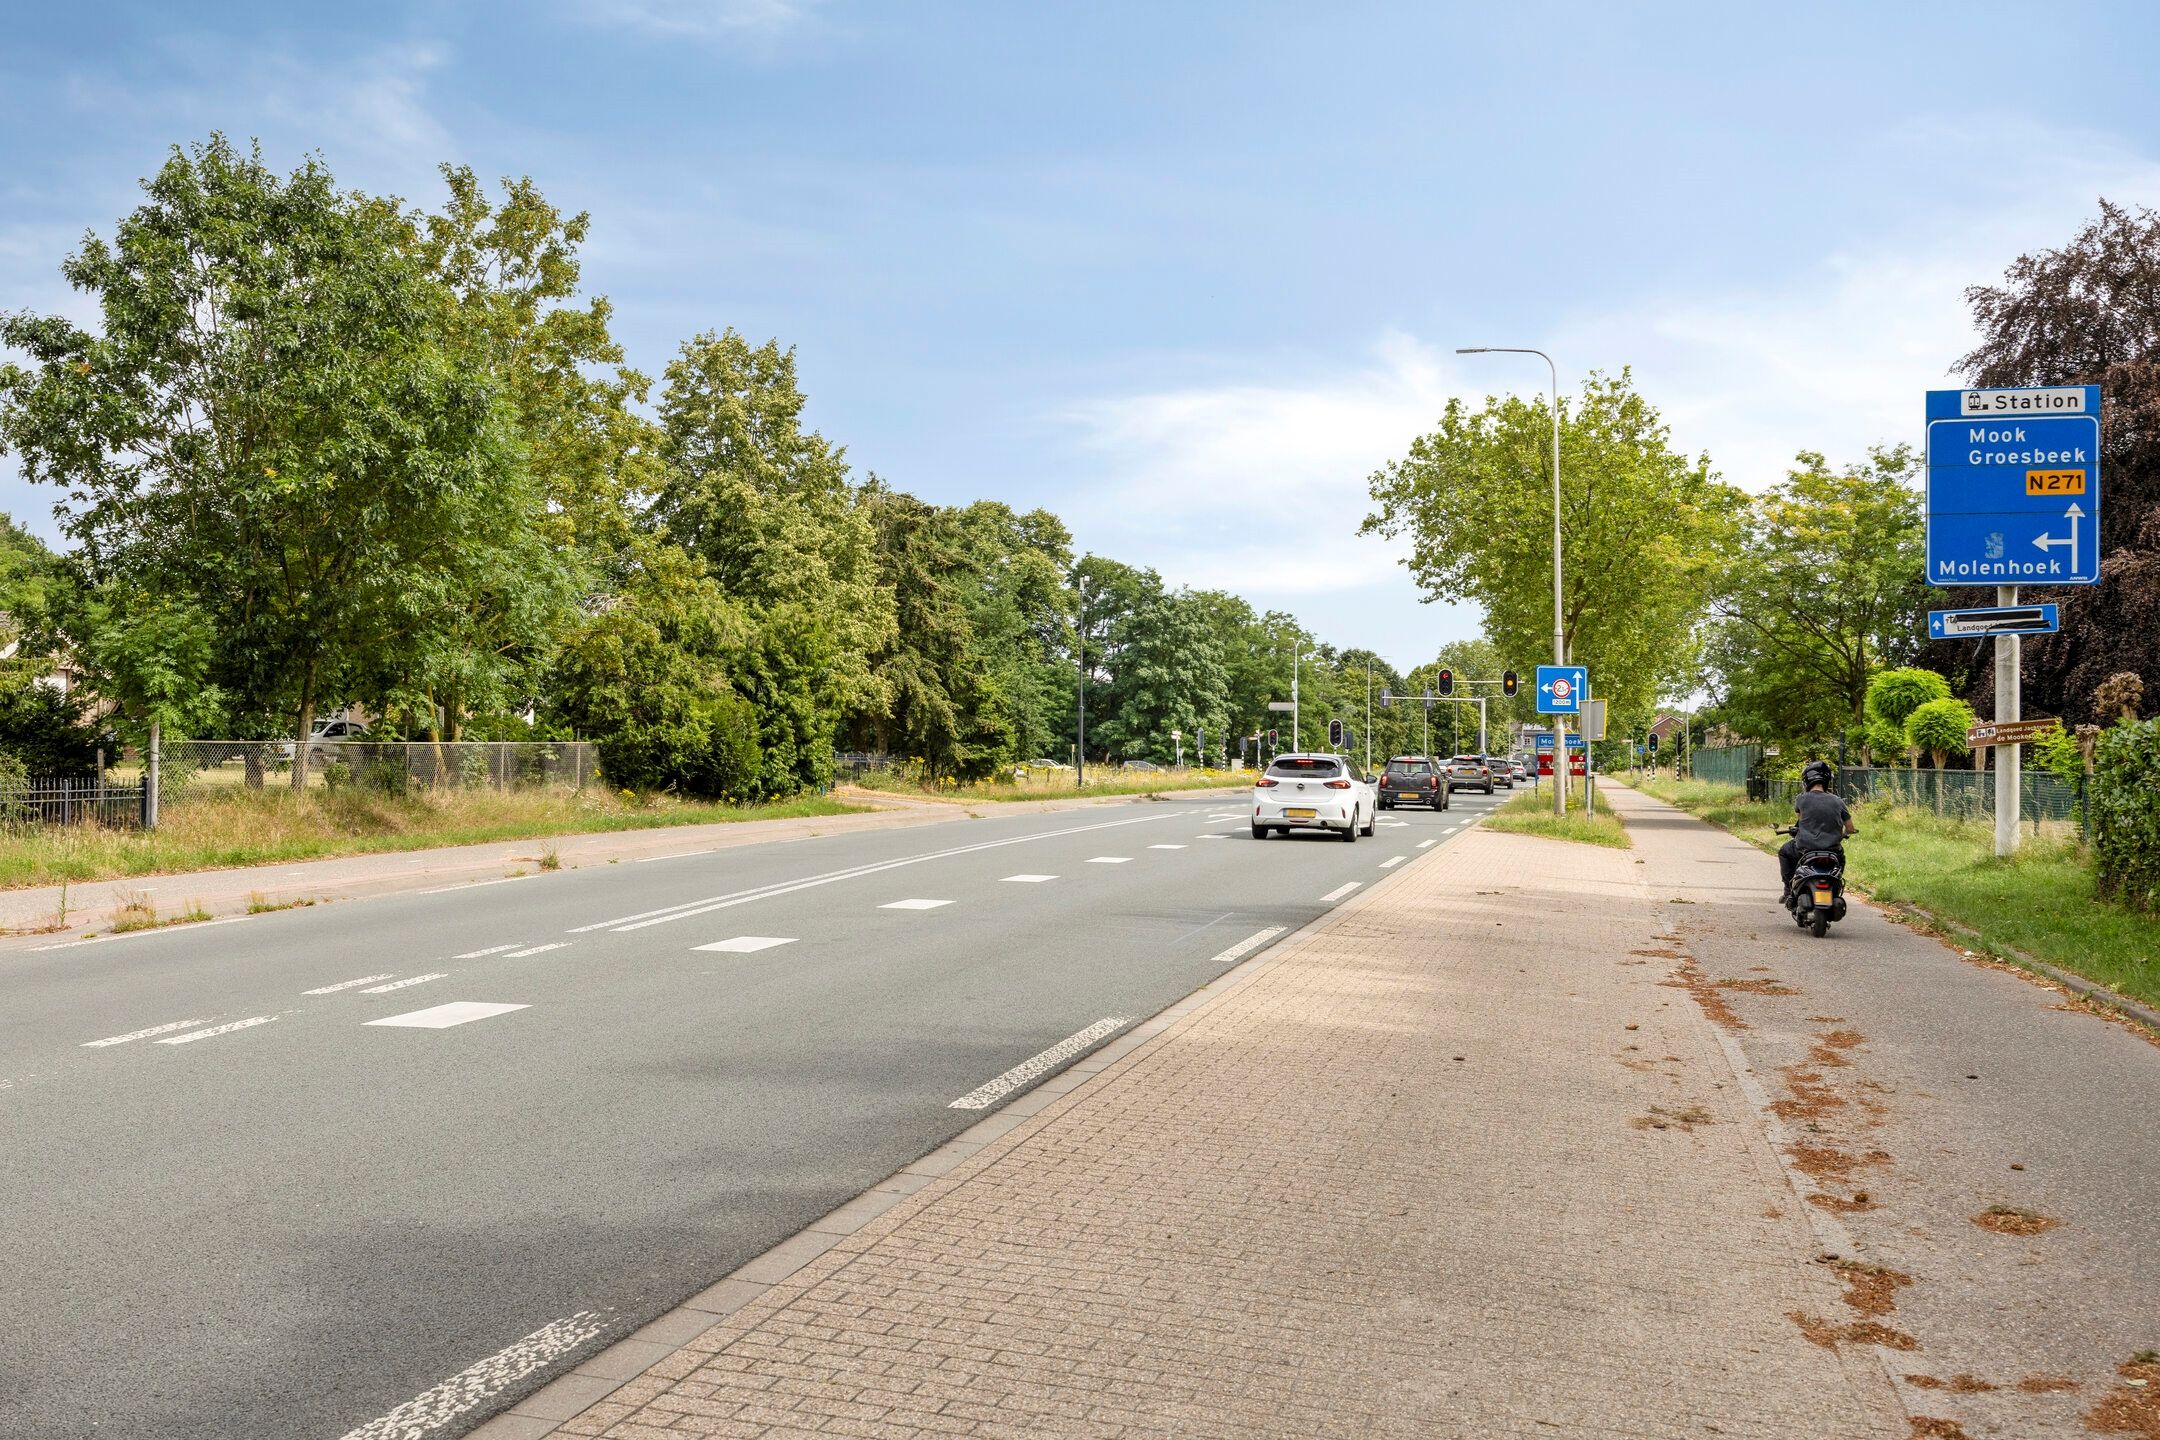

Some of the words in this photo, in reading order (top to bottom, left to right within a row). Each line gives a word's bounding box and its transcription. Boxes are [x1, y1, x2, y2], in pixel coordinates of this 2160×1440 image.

[1995, 395, 2078, 409] Station
[1969, 427, 2026, 444] Mook
[1969, 448, 2086, 465] Groesbeek
[2030, 475, 2082, 490] N271
[1940, 560, 2061, 576] Molenhoek
[1997, 734, 2005, 742] de
